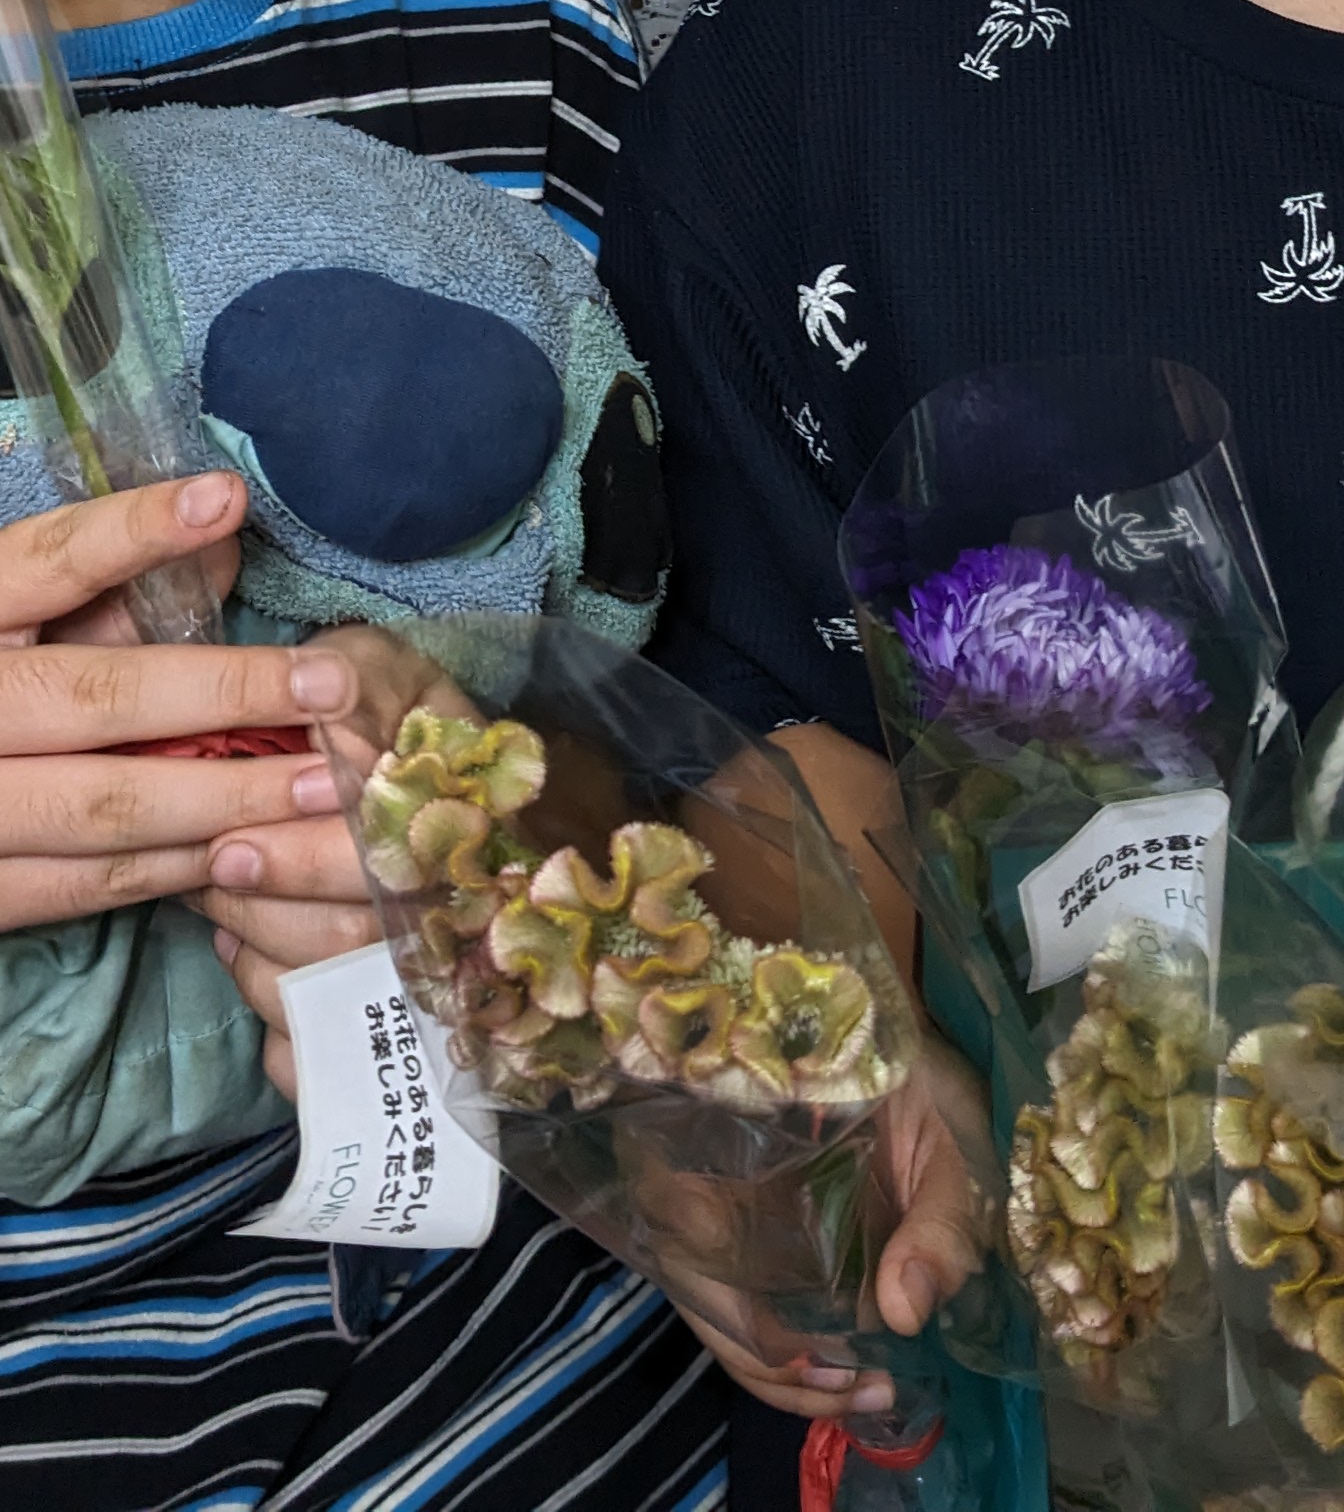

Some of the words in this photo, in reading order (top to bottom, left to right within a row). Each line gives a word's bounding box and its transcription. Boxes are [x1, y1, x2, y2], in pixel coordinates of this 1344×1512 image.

[389, 993, 436, 1234] お花のある暮らしを
